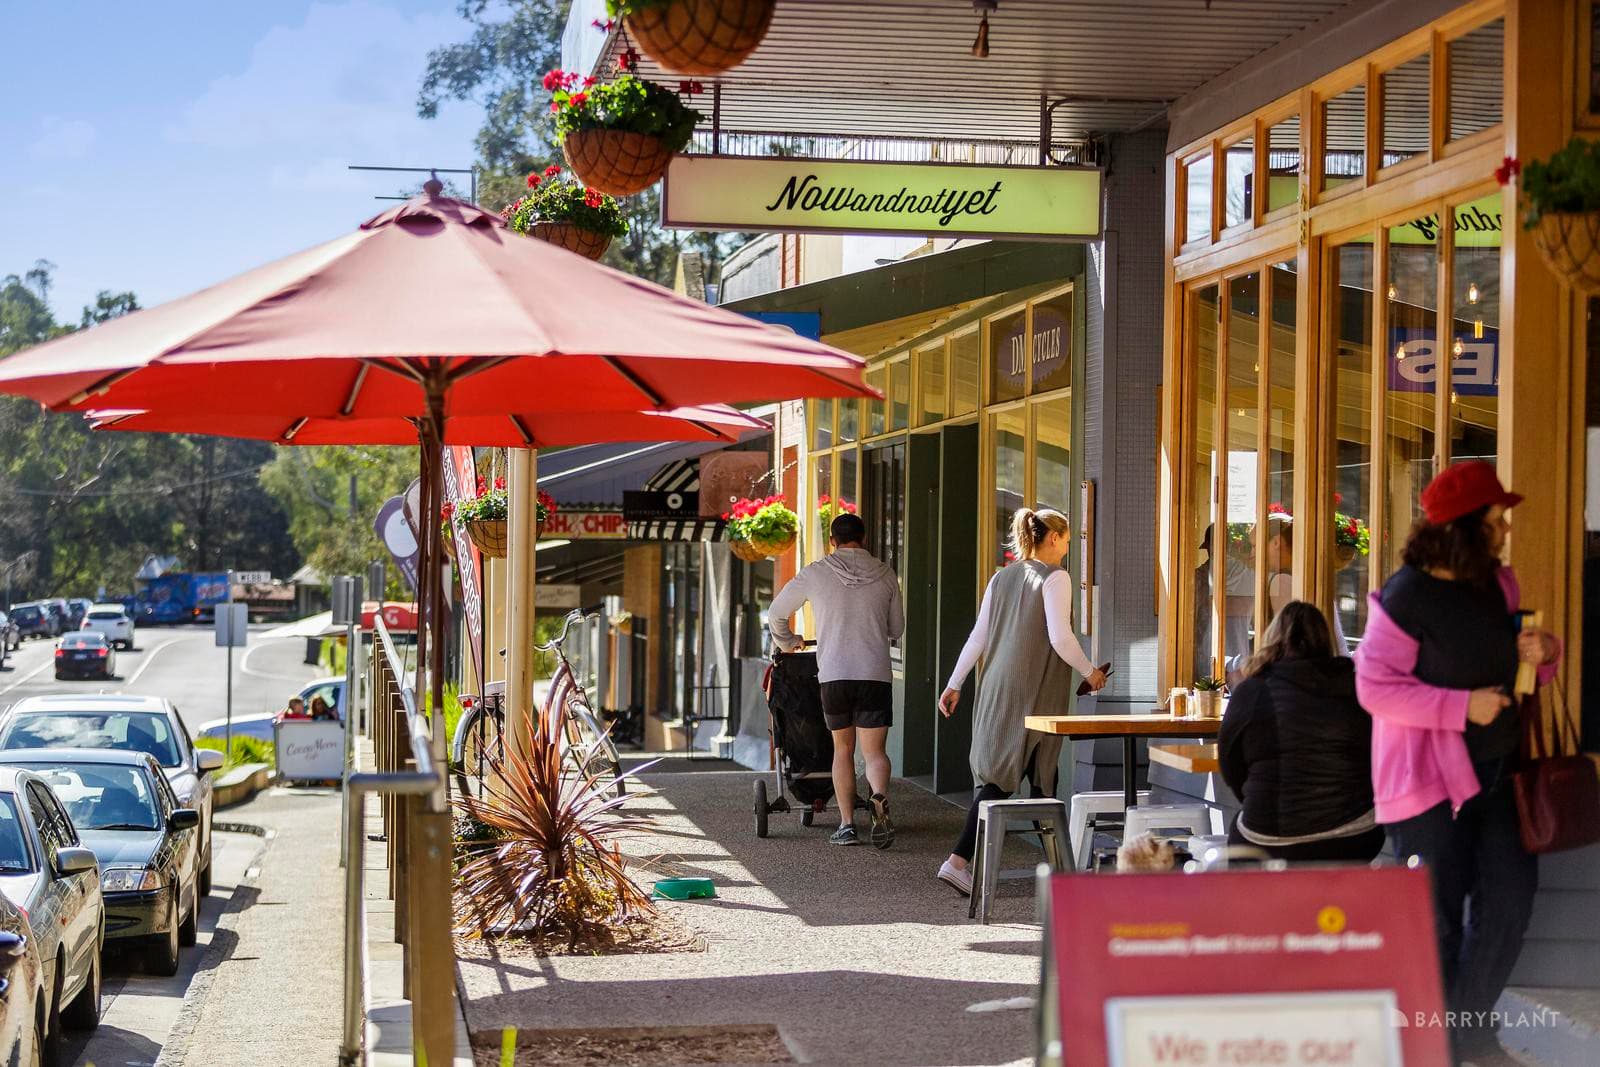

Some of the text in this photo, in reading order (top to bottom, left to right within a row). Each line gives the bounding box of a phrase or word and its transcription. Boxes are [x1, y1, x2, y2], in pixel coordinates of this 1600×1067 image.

[765, 174, 1002, 226] Nowandnotyet
[1032, 326, 1061, 364] CYCLES
[1150, 1031, 1357, 1064] We rate our
